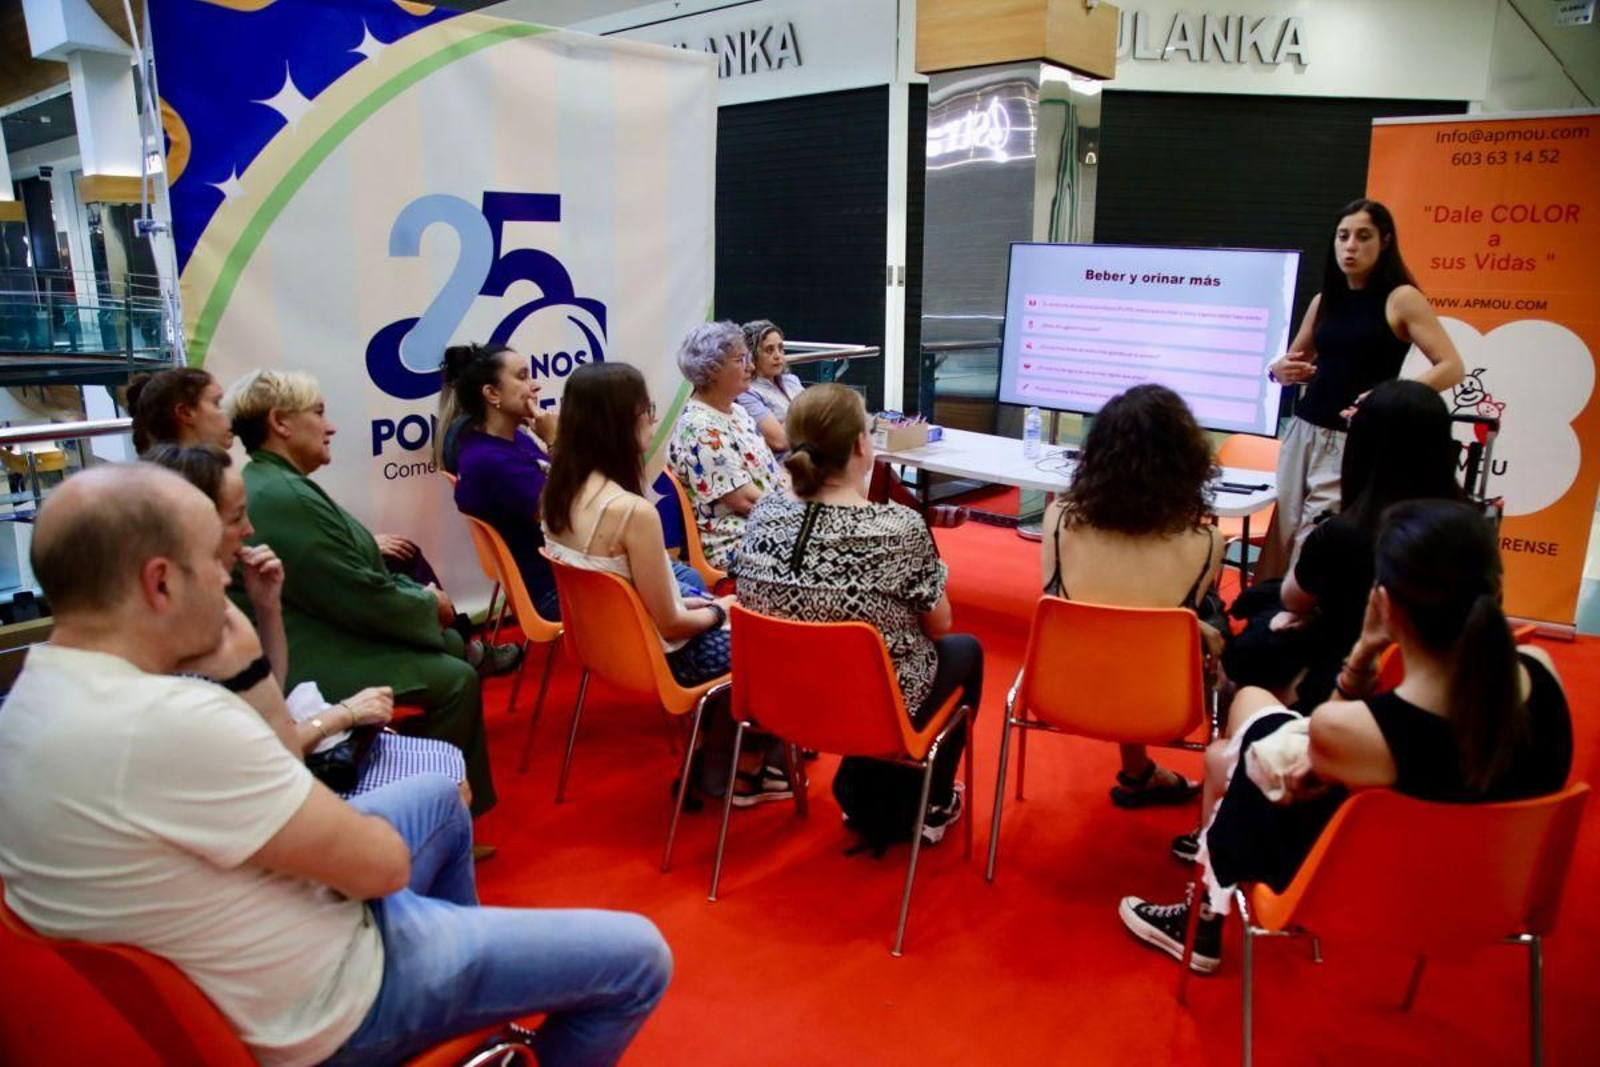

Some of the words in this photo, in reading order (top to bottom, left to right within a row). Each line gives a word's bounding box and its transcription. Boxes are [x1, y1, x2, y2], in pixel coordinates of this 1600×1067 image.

[1451, 151, 1482, 167] 603
[1486, 151, 1507, 166] 63
[1514, 150, 1533, 165] 14
[1538, 149, 1560, 164] 52
[1491, 203, 1581, 224] COLOR
[1487, 233, 1501, 248] a
[1430, 256, 1466, 270] sus
[1475, 252, 1536, 272] Vidas
[1085, 268, 1126, 282] Beber
[1129, 273, 1138, 285] y
[1142, 272, 1185, 286] orinar
[1189, 274, 1222, 288] más
